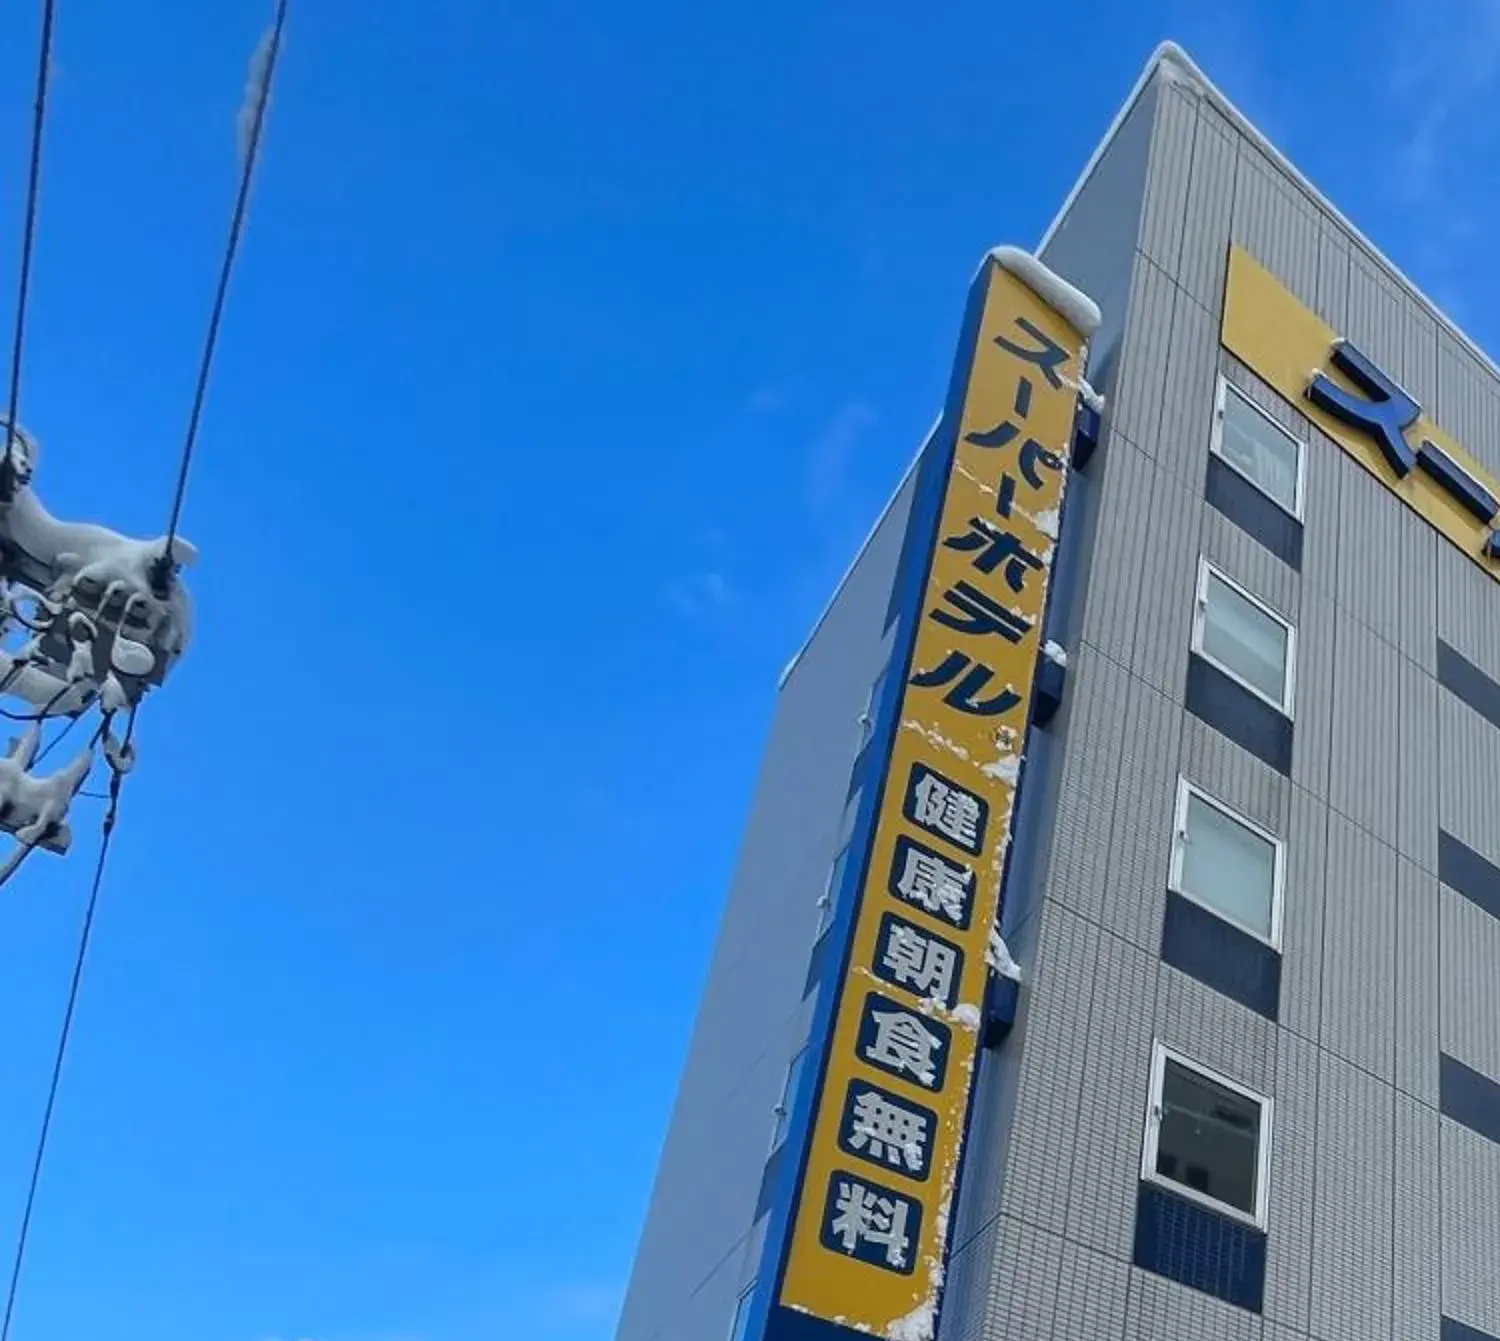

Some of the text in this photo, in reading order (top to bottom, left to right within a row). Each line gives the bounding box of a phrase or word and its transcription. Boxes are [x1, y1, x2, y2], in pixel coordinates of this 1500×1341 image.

[907, 317, 1072, 716] スーパーホテル
[826, 769, 986, 1272] 健康朝食無料
